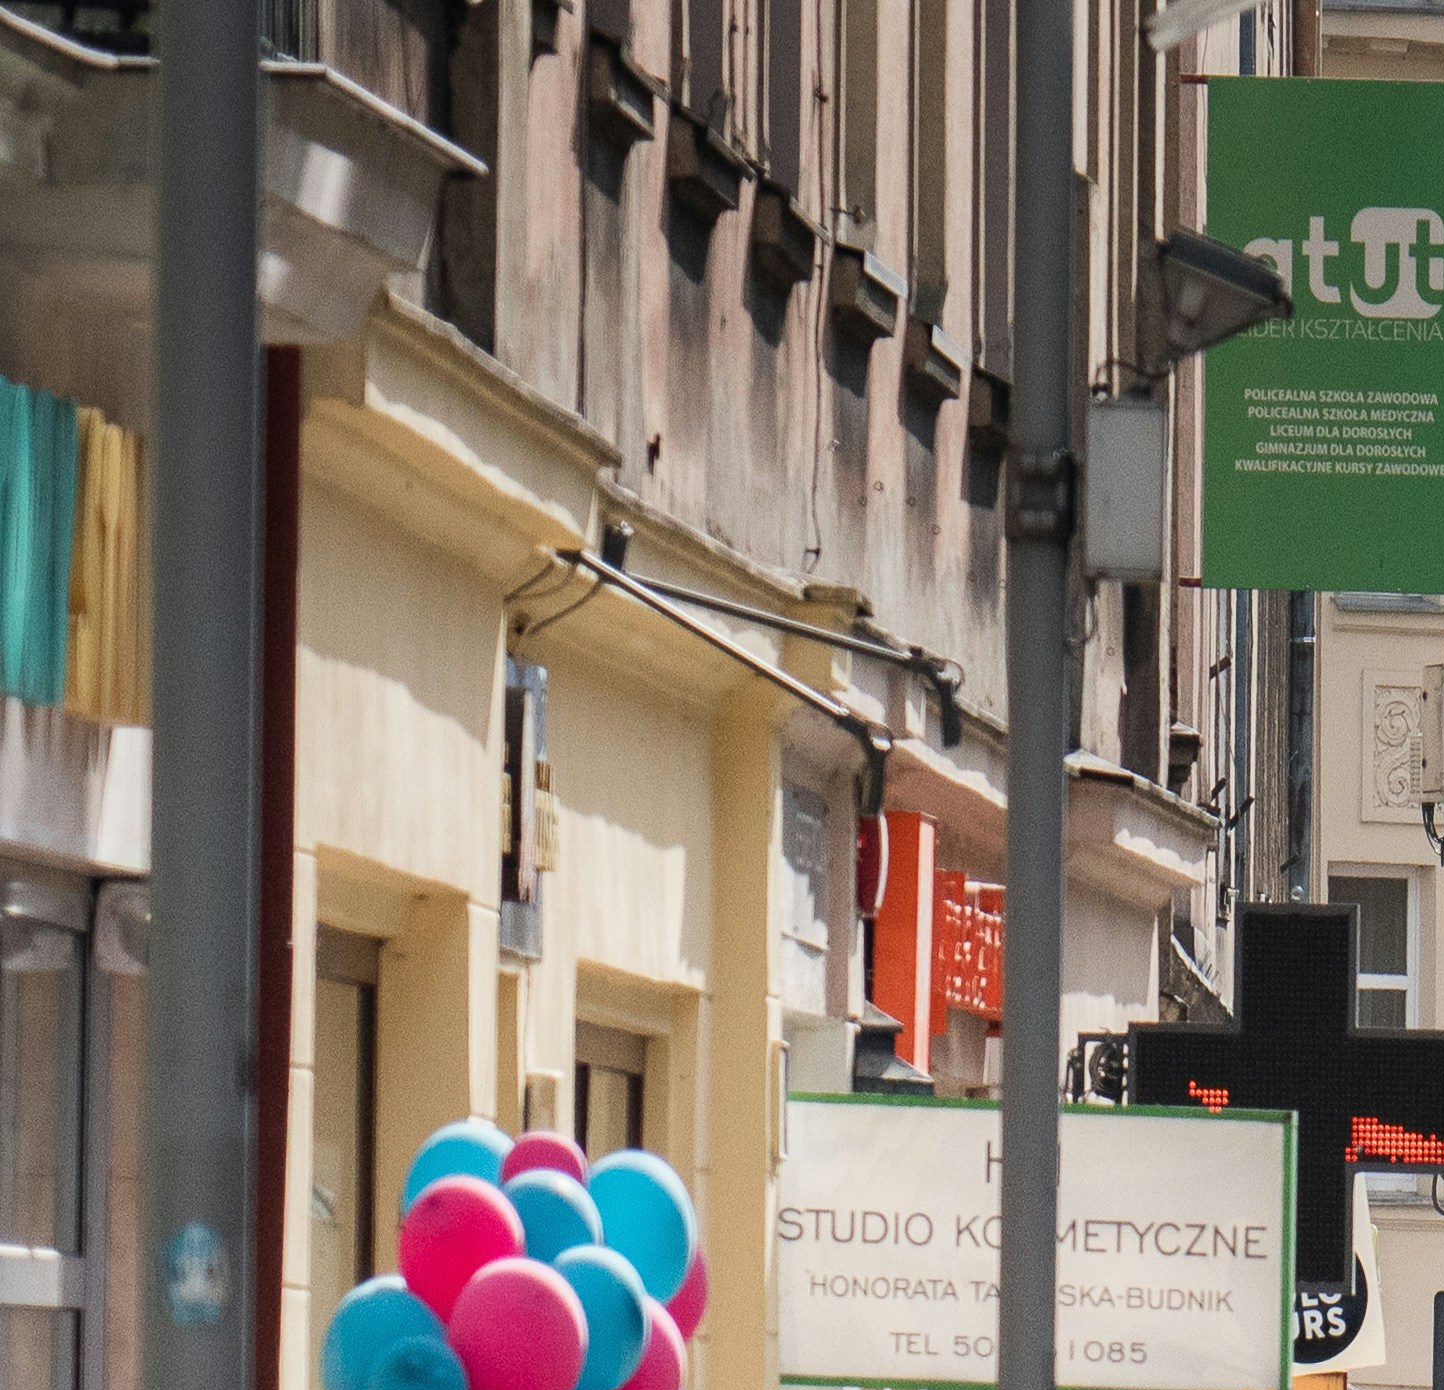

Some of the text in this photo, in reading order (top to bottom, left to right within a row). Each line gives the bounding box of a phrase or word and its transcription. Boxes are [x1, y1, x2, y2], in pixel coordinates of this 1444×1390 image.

[1300, 318, 1443, 341] KSZTAŁCENIA
[1244, 388, 1439, 406] POLICEALNA SZKOŁA ZAWODOWA
[1248, 406, 1434, 423] POLICEALNA SZKOŁA MEDYCZNA
[1270, 425, 1412, 440] LICEUM DLA DOROSŁYCH
[1256, 441, 1426, 458] GIMNAZJUM DLA DOROSŁYCH
[1235, 459, 1333, 474] KWALIFIKACYJNE
[1335, 462, 1374, 475] KURSY
[777, 1207, 1268, 1260] STUDIO KOMETYCZNE
[809, 1274, 1235, 1313] HONORATA TASKA-BUDNIK
[890, 1331, 939, 1356] TEL
[954, 1335, 995, 1358] 50
